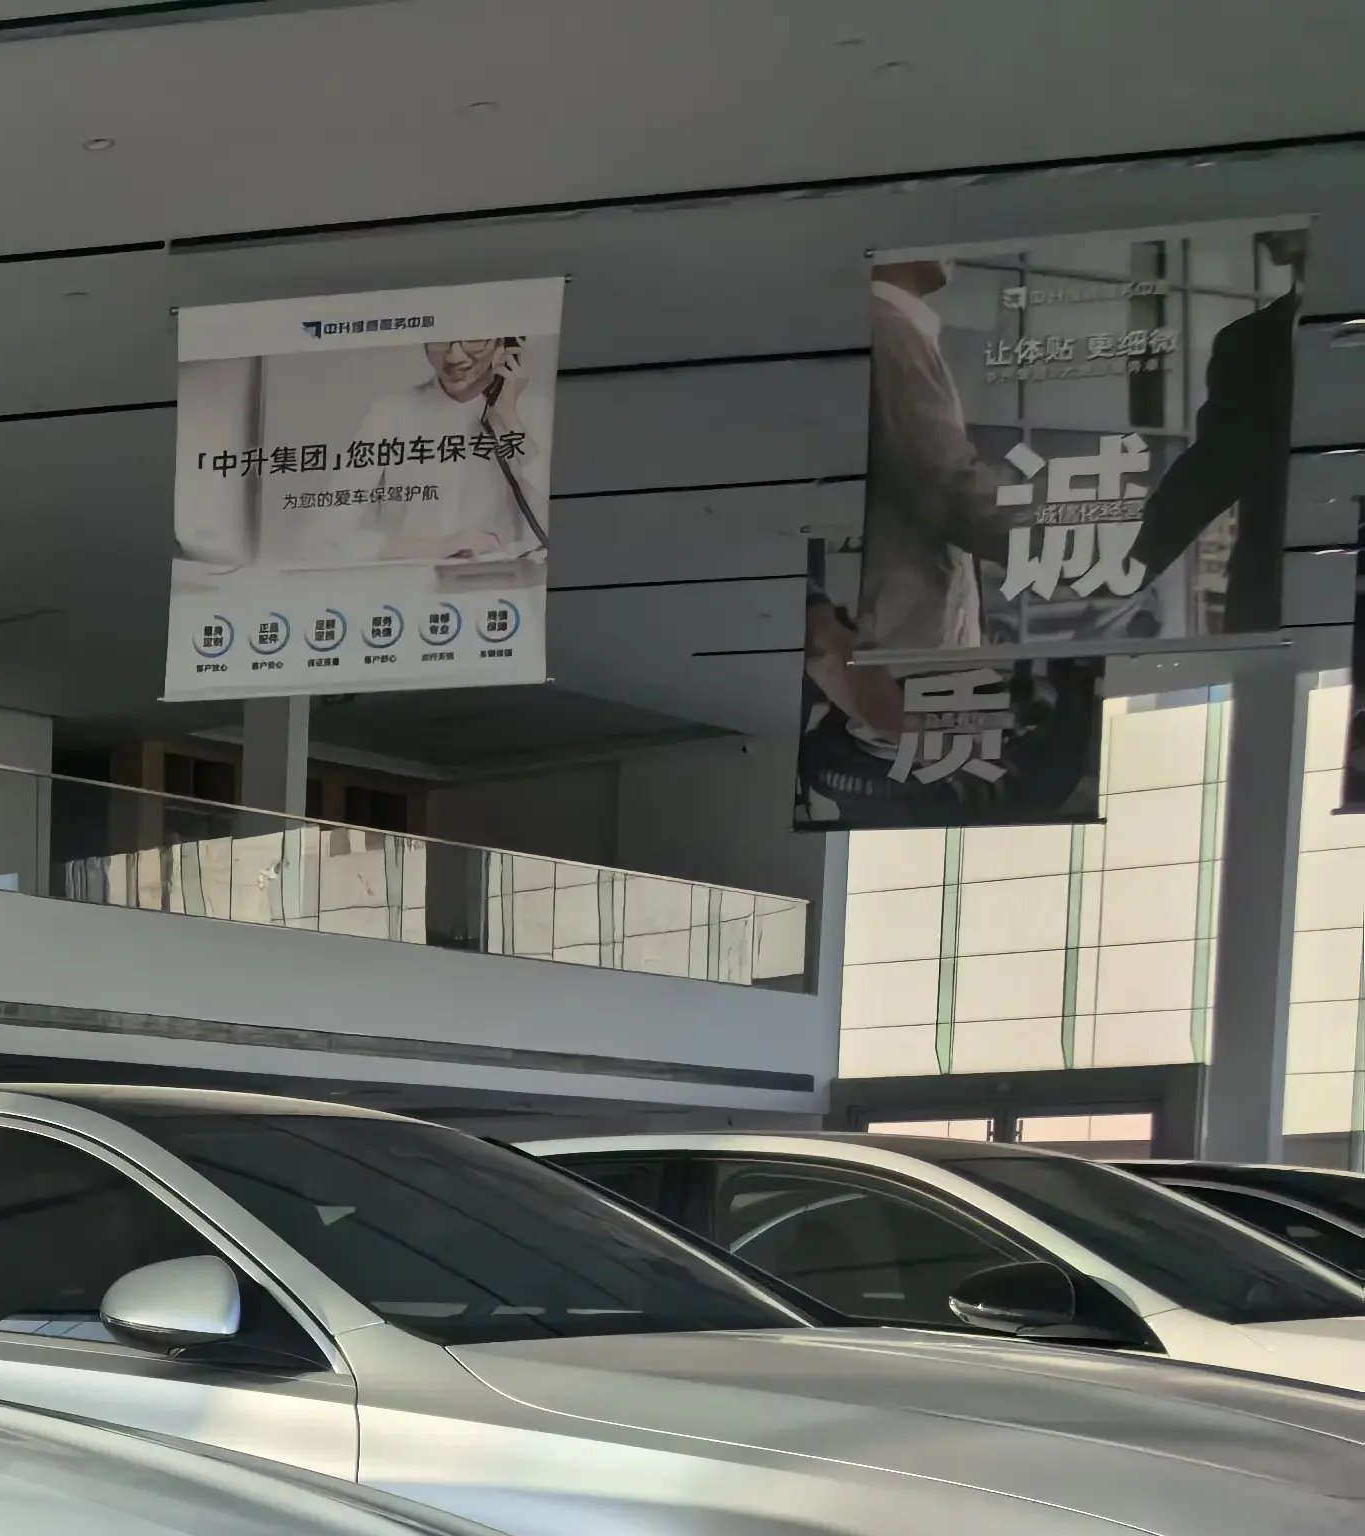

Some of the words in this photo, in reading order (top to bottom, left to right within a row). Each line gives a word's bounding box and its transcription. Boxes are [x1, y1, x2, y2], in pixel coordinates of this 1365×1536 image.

[197, 430, 526, 478] 「中升集团」您的车保专家
[282, 484, 440, 510] 为您的爱车保驾护航
[996, 432, 1151, 601] 诚
[887, 667, 1011, 785] 质
